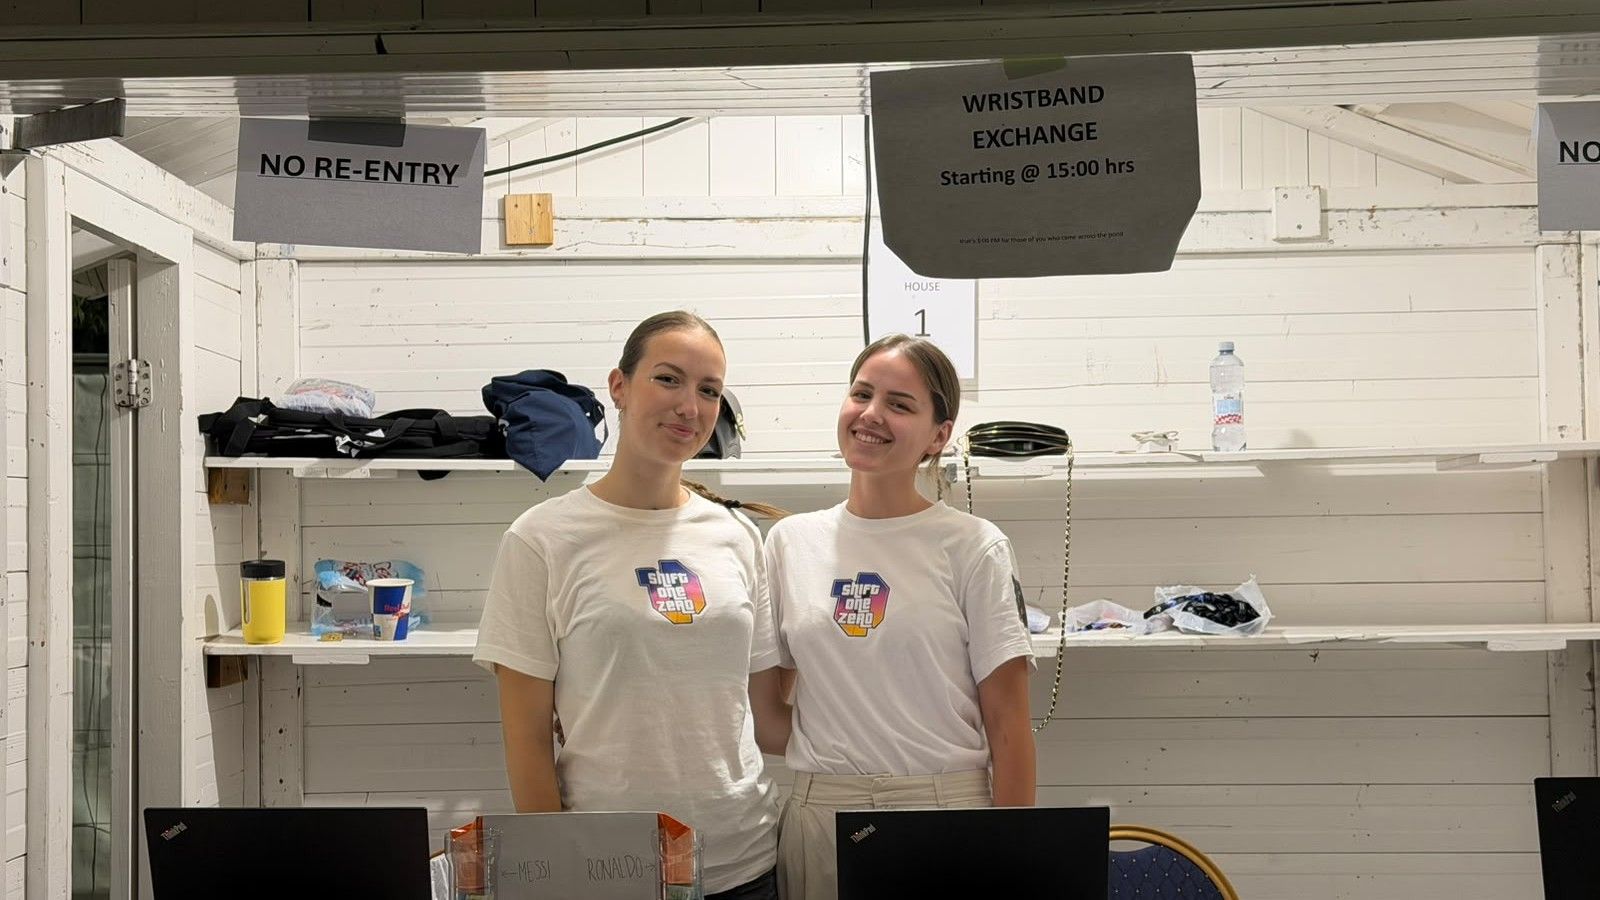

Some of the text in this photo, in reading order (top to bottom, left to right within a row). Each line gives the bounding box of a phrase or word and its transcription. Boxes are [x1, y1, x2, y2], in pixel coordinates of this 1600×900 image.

[962, 85, 1105, 113] WRISTBAND
[972, 121, 1098, 150] EXCHANGE
[1559, 140, 1600, 163] NO
[260, 153, 460, 185] NO RE-ENTRY
[940, 157, 1135, 186] Starting @ 15:00 hrs
[904, 281, 940, 291] HOUSE
[914, 308, 931, 337] 1
[518, 854, 644, 882] MESSI RONALDO
